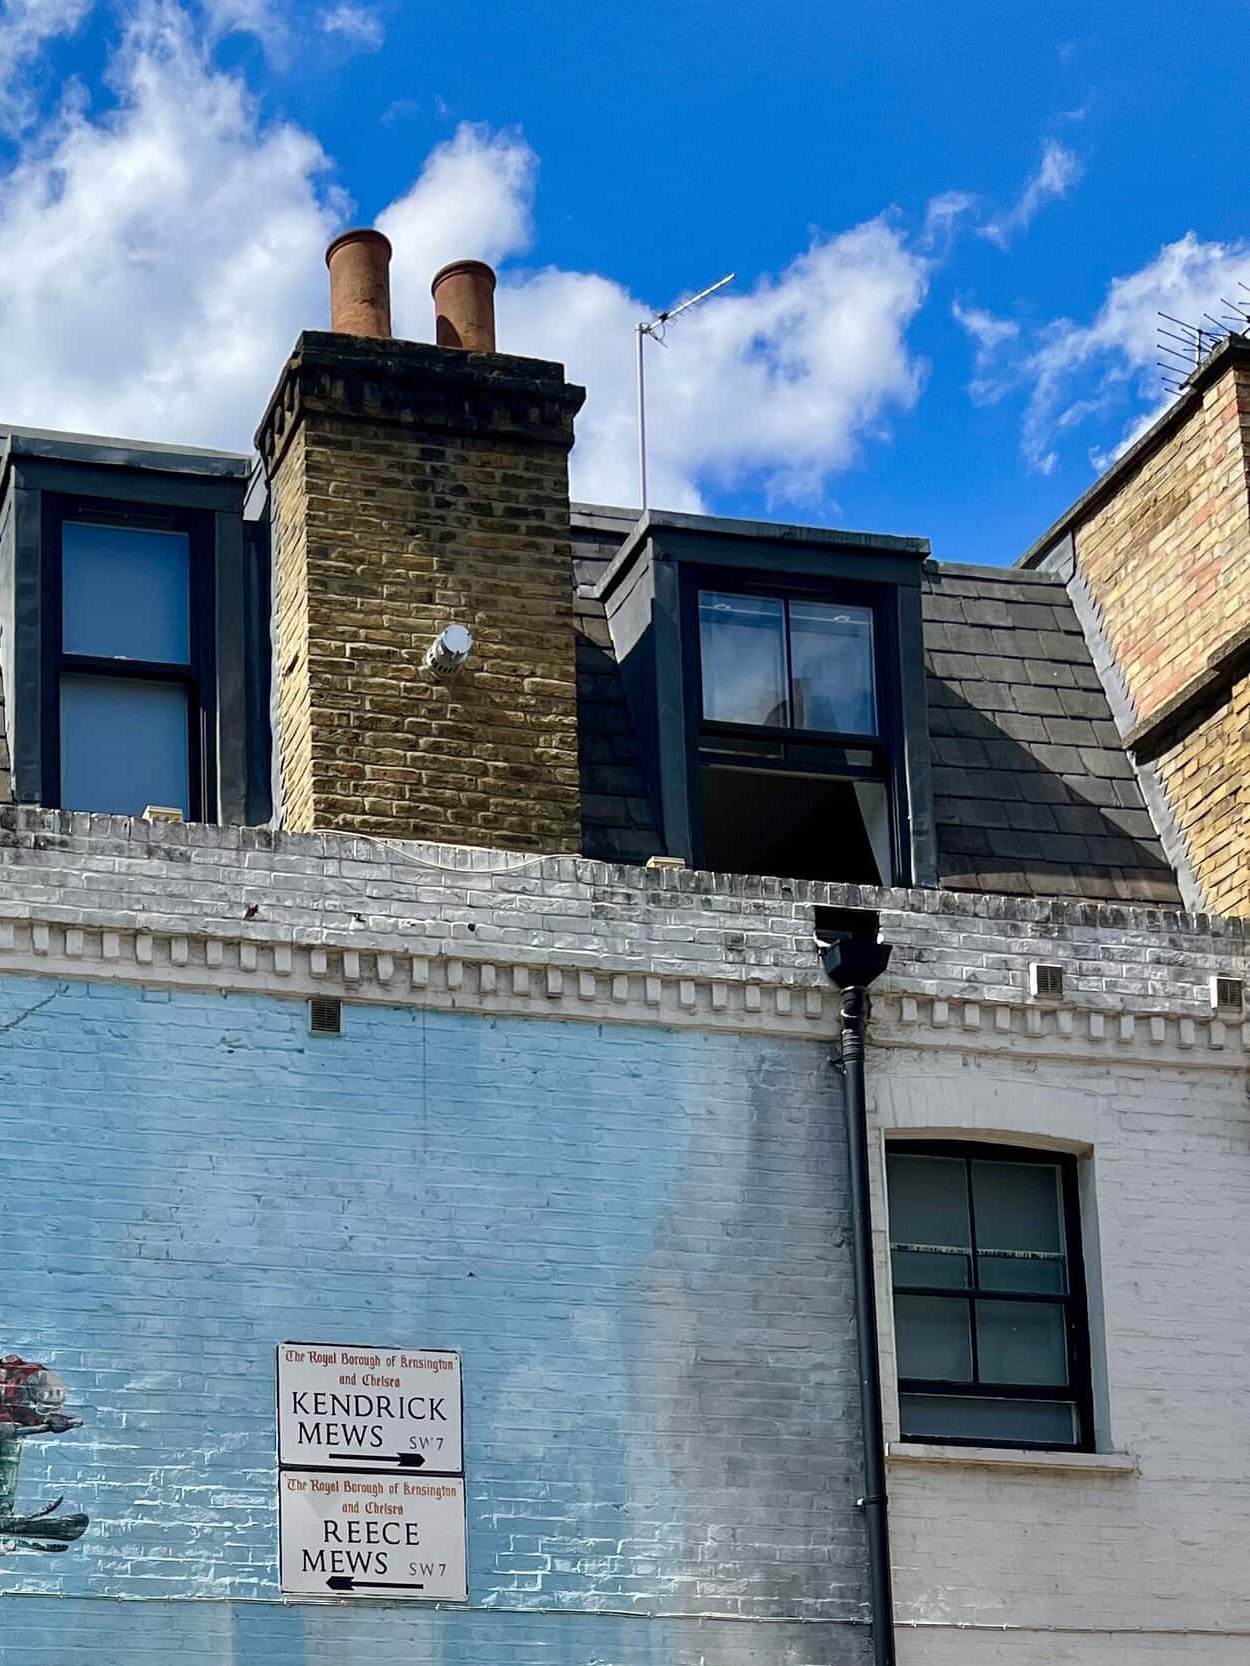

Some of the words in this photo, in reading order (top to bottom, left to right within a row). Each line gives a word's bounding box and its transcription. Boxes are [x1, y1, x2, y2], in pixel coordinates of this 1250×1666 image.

[285, 1350, 305, 1362] The
[308, 1351, 336, 1368] Royal
[341, 1352, 381, 1370] Borough
[385, 1355, 396, 1367] of
[400, 1354, 454, 1373] Kensington
[339, 1373, 357, 1386] and
[361, 1373, 401, 1388] Chelsea
[292, 1391, 447, 1421] KENDRICK
[297, 1421, 383, 1448] MEWS
[287, 1478, 307, 1491] The
[310, 1479, 339, 1496] Royal
[343, 1480, 384, 1497] Borough
[388, 1482, 399, 1495] of
[403, 1482, 457, 1500] Kensington
[342, 1501, 359, 1514] and
[365, 1502, 404, 1515] Chelsea
[323, 1519, 420, 1546] REECE
[301, 1549, 388, 1575] MEWS
